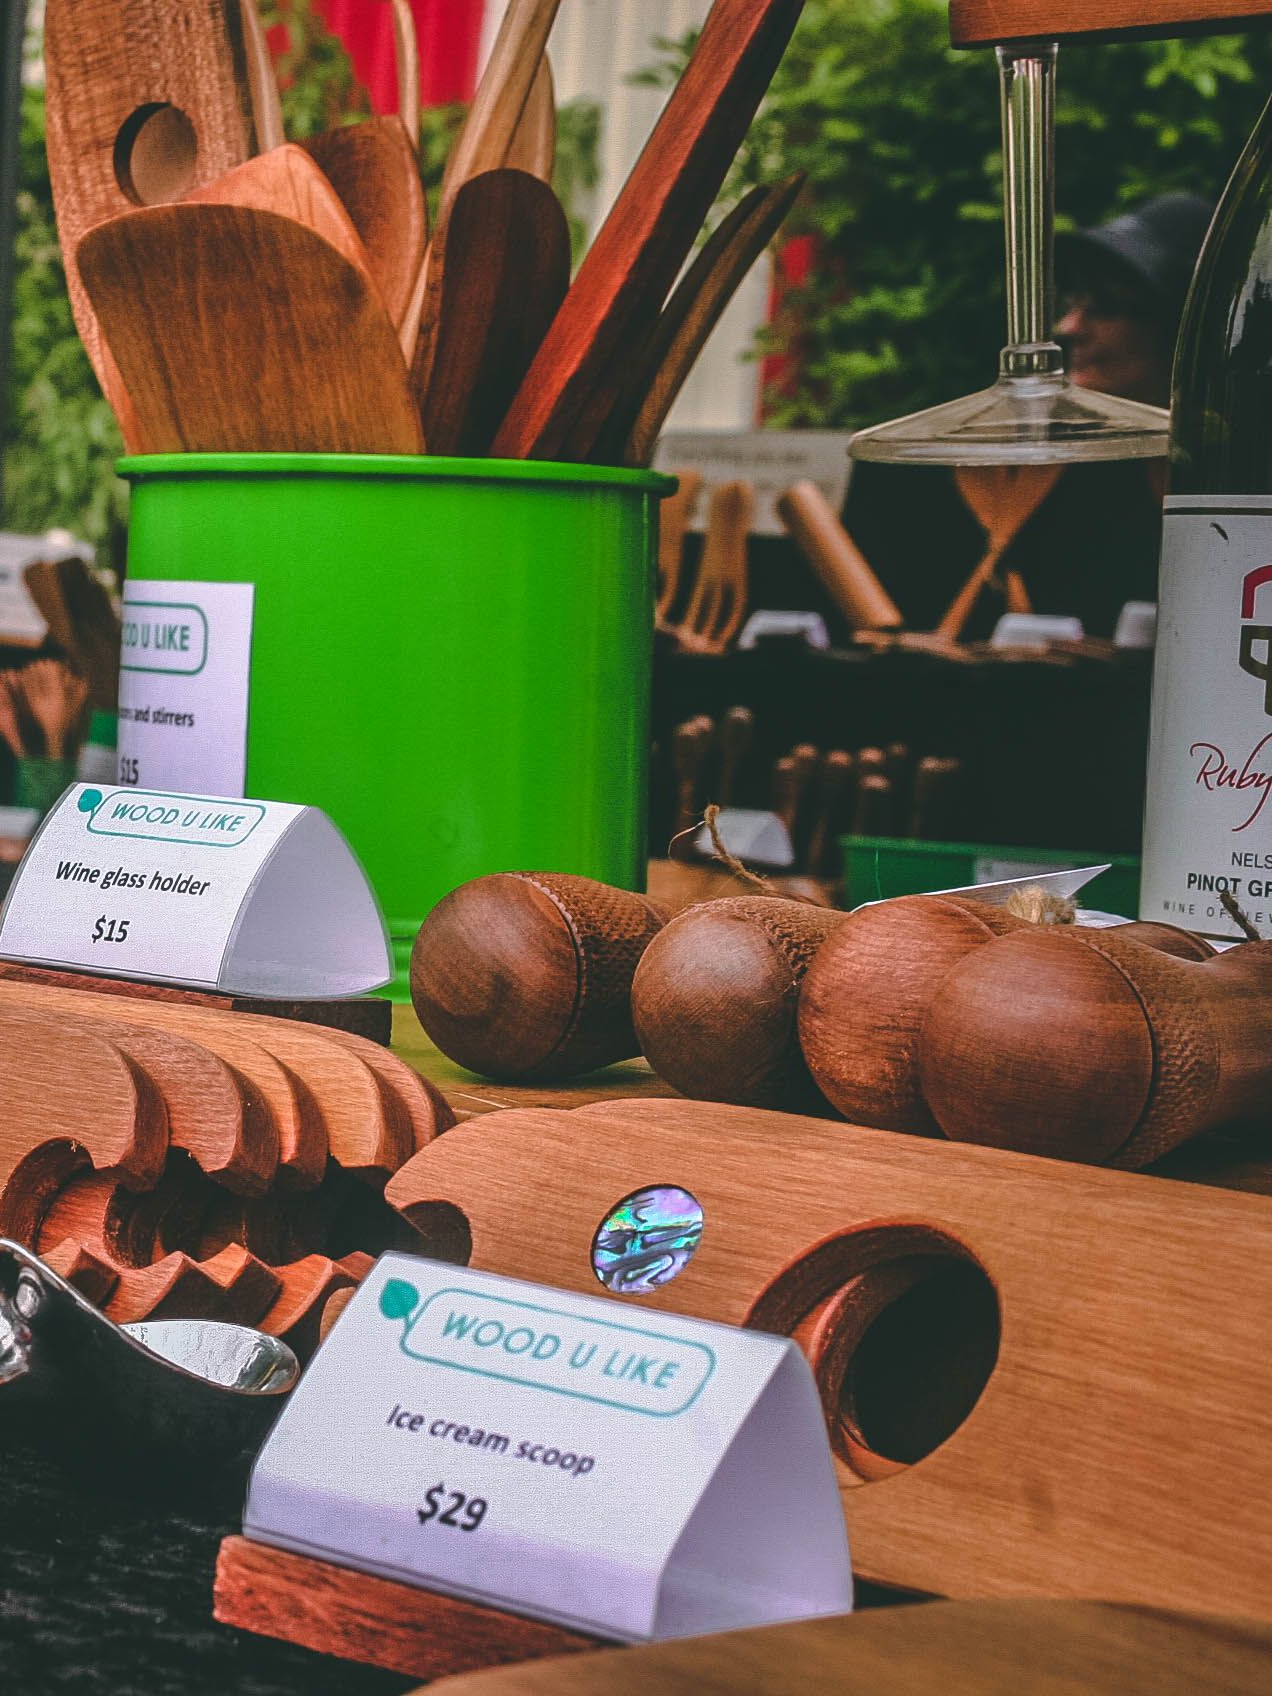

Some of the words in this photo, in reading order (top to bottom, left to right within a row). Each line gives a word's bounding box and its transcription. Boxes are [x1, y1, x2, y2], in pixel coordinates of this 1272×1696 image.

[141, 623, 151, 649] U
[155, 624, 190, 652] LIKE
[152, 707, 195, 728] stirrers
[111, 802, 179, 825] WOOD
[181, 809, 201, 828] U
[199, 811, 246, 832] LIKE
[55, 860, 101, 884] Wine
[100, 866, 147, 890] glass
[148, 870, 211, 896] holder
[1186, 872, 1242, 896] PINOT
[1163, 900, 1196, 915] WINE
[91, 914, 131, 944] $15
[442, 1310, 561, 1360] WOOD
[568, 1341, 598, 1370] U
[602, 1349, 680, 1390] LIKE
[385, 1402, 425, 1433] Ice
[428, 1418, 511, 1453] cream
[514, 1440, 596, 1478] scoop
[416, 1480, 489, 1533] $29
